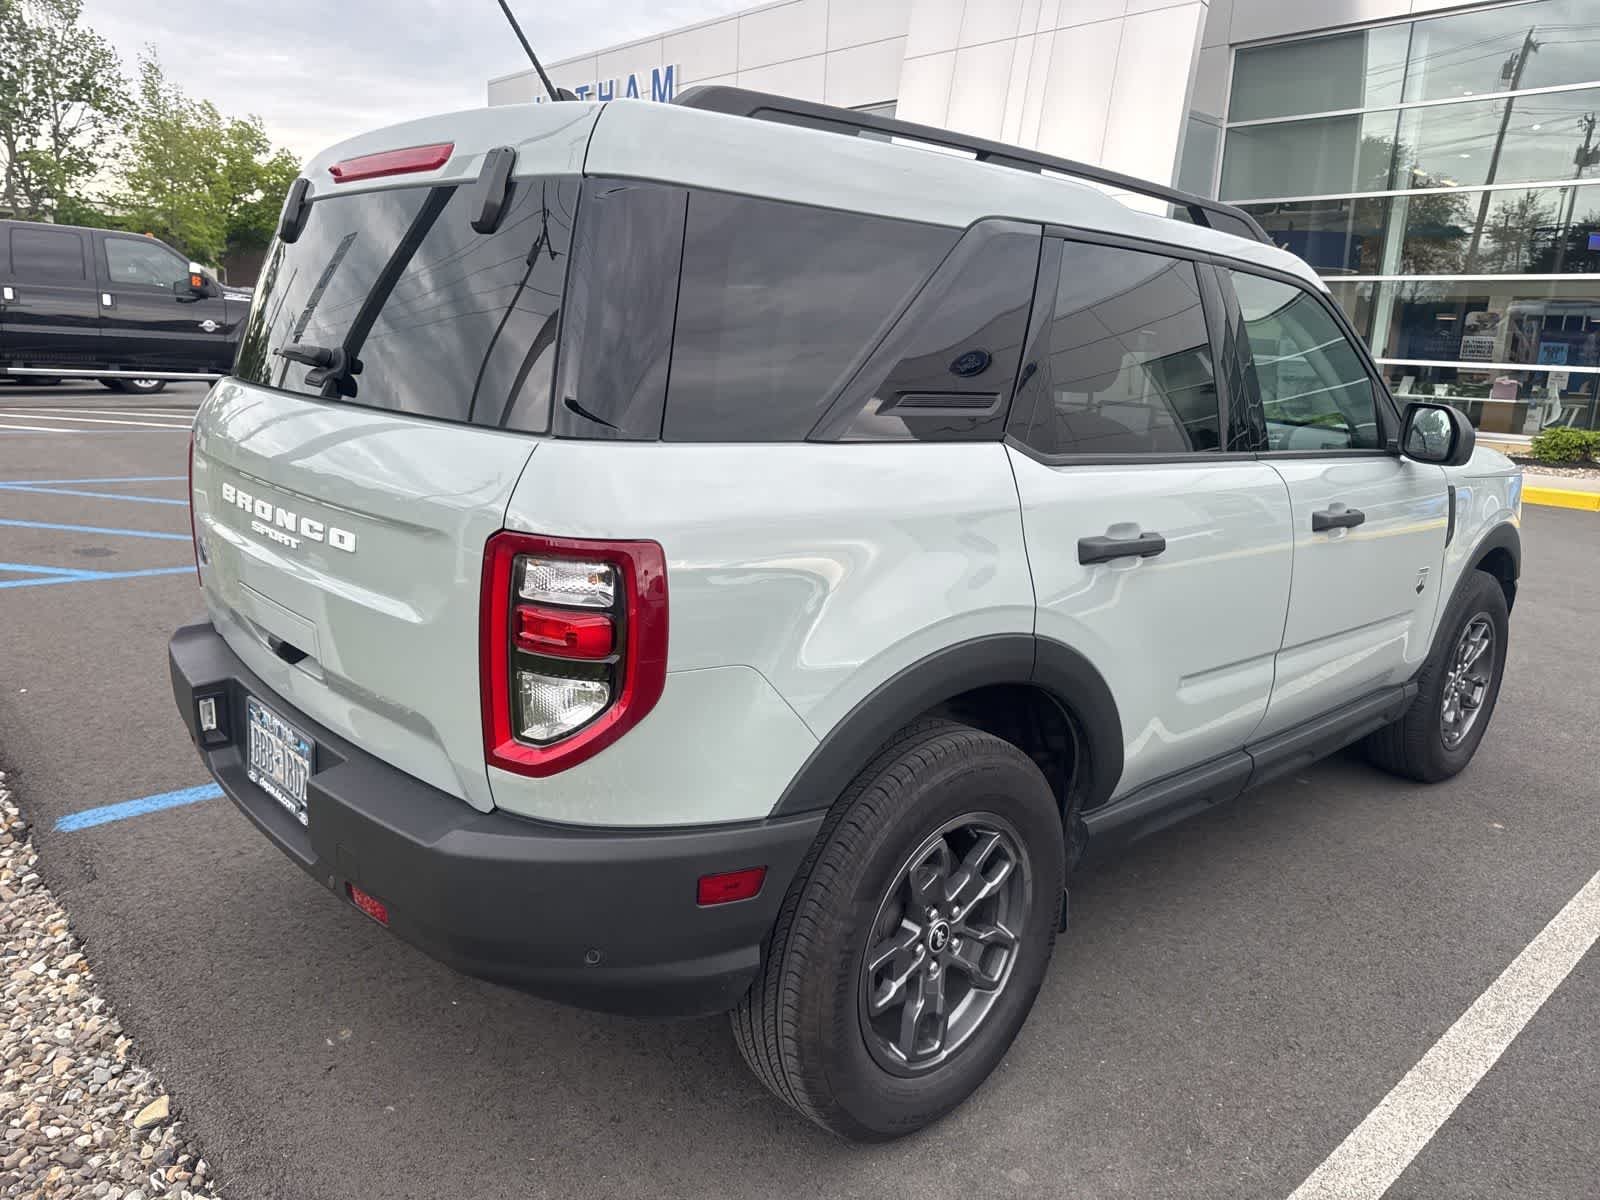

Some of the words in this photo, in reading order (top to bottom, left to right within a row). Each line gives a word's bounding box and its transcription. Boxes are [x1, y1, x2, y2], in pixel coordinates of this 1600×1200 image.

[536, 64, 674, 103] THAM
[222, 482, 356, 553] BRONCO
[251, 520, 301, 549] SPORT
